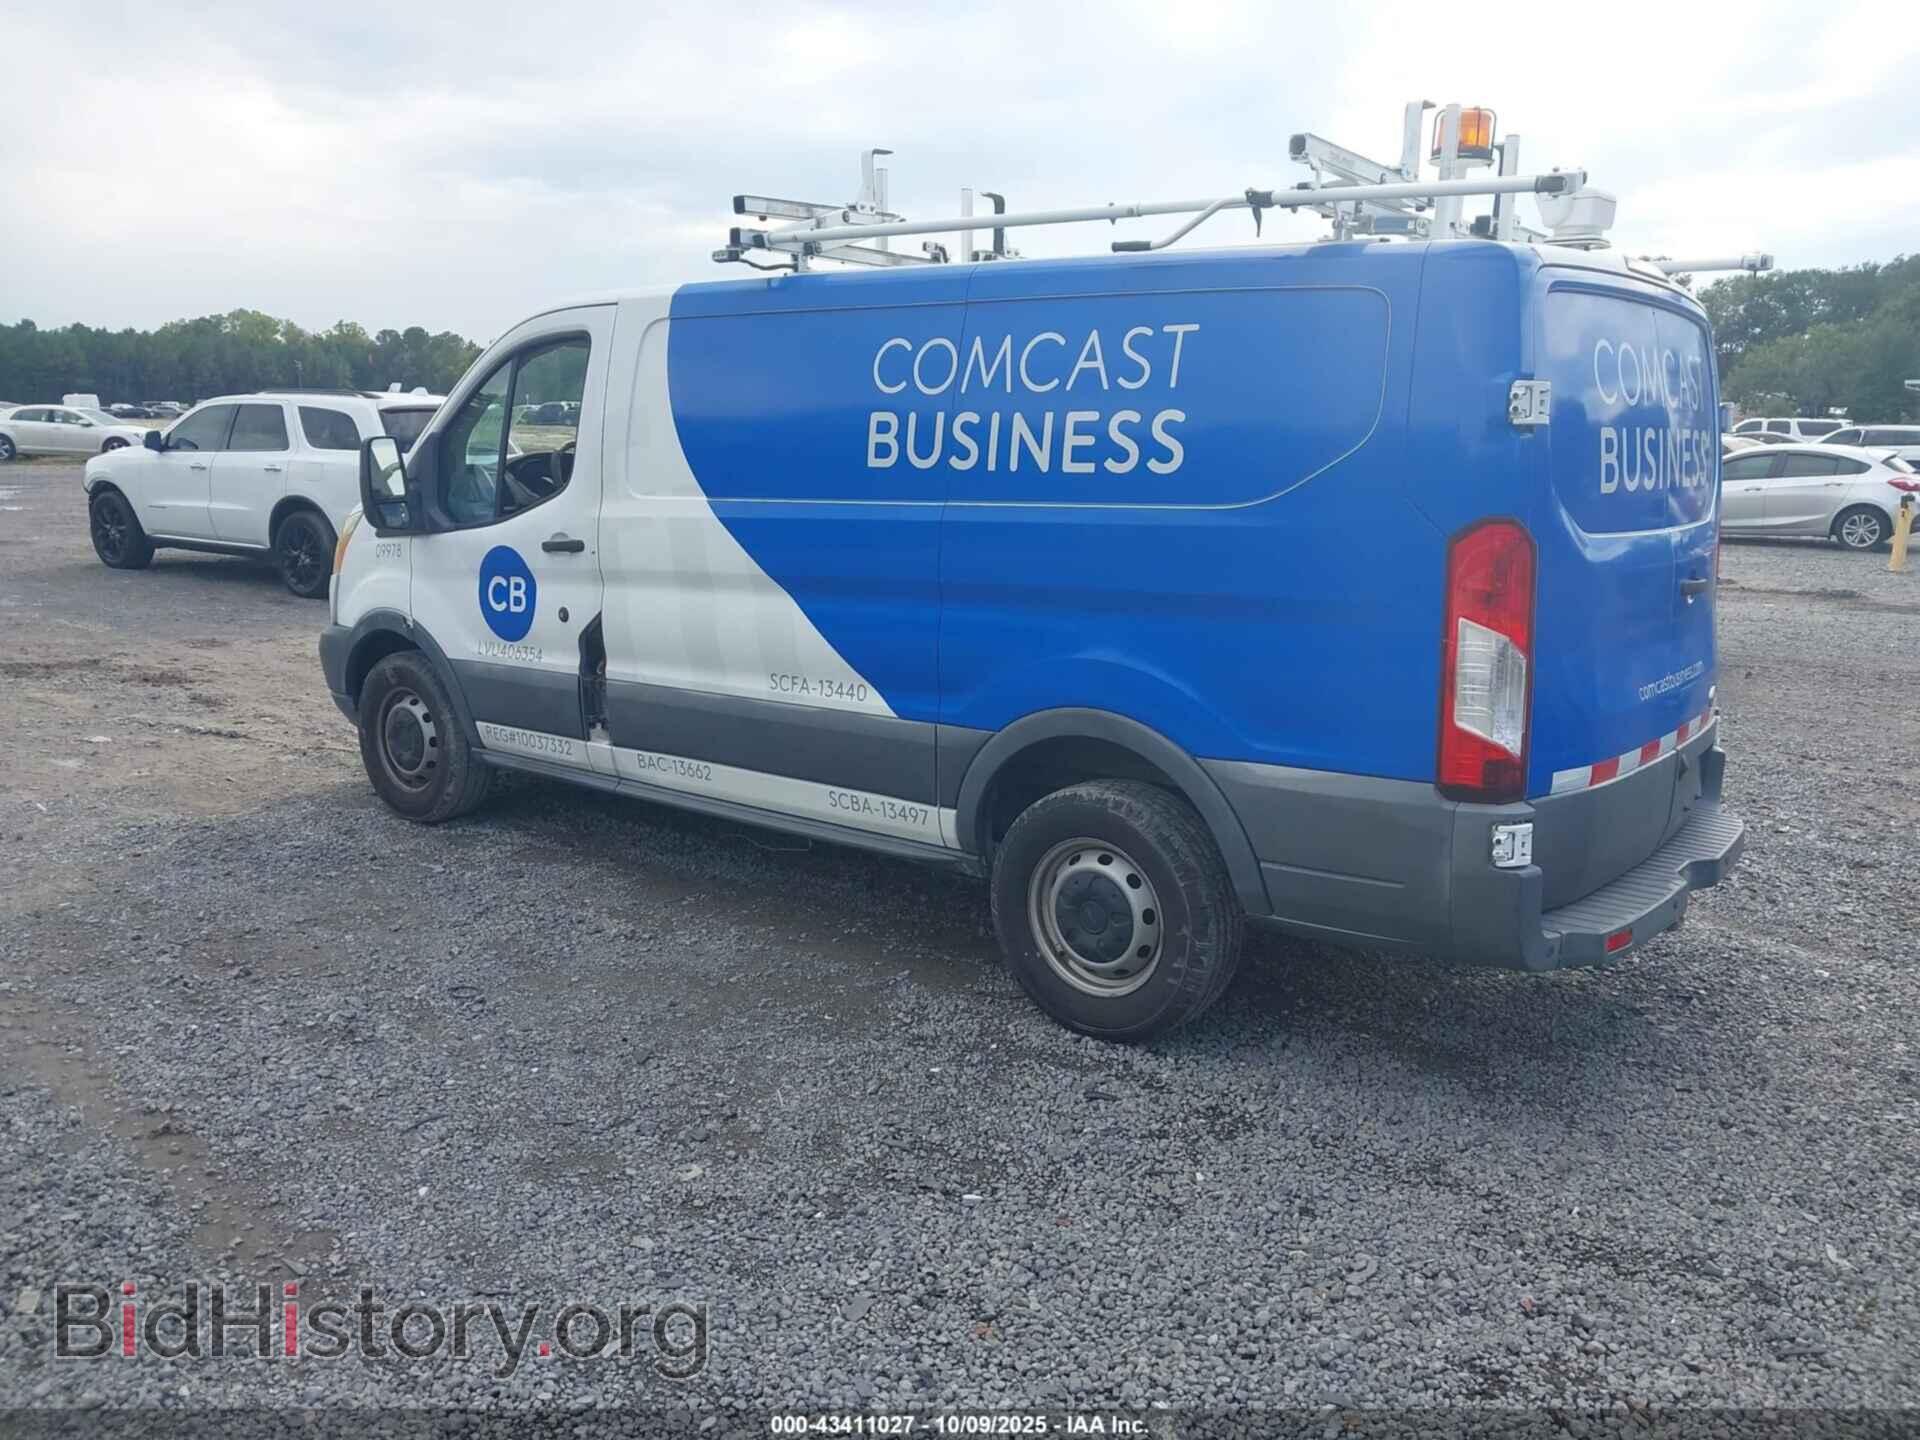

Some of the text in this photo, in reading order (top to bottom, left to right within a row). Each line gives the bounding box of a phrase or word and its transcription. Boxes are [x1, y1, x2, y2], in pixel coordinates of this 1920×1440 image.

[873, 323, 1200, 395] COMCAST
[1594, 338, 1703, 411] COMCAST
[867, 409, 1186, 474] BUSINESS
[1600, 426, 1709, 494] BUSINESS
[488, 576, 526, 613] CB
[769, 673, 867, 702] SCFA-13440
[485, 724, 573, 757] REG#10037332
[636, 752, 713, 782] BAC-13662
[828, 790, 929, 826] SCBA-13497
